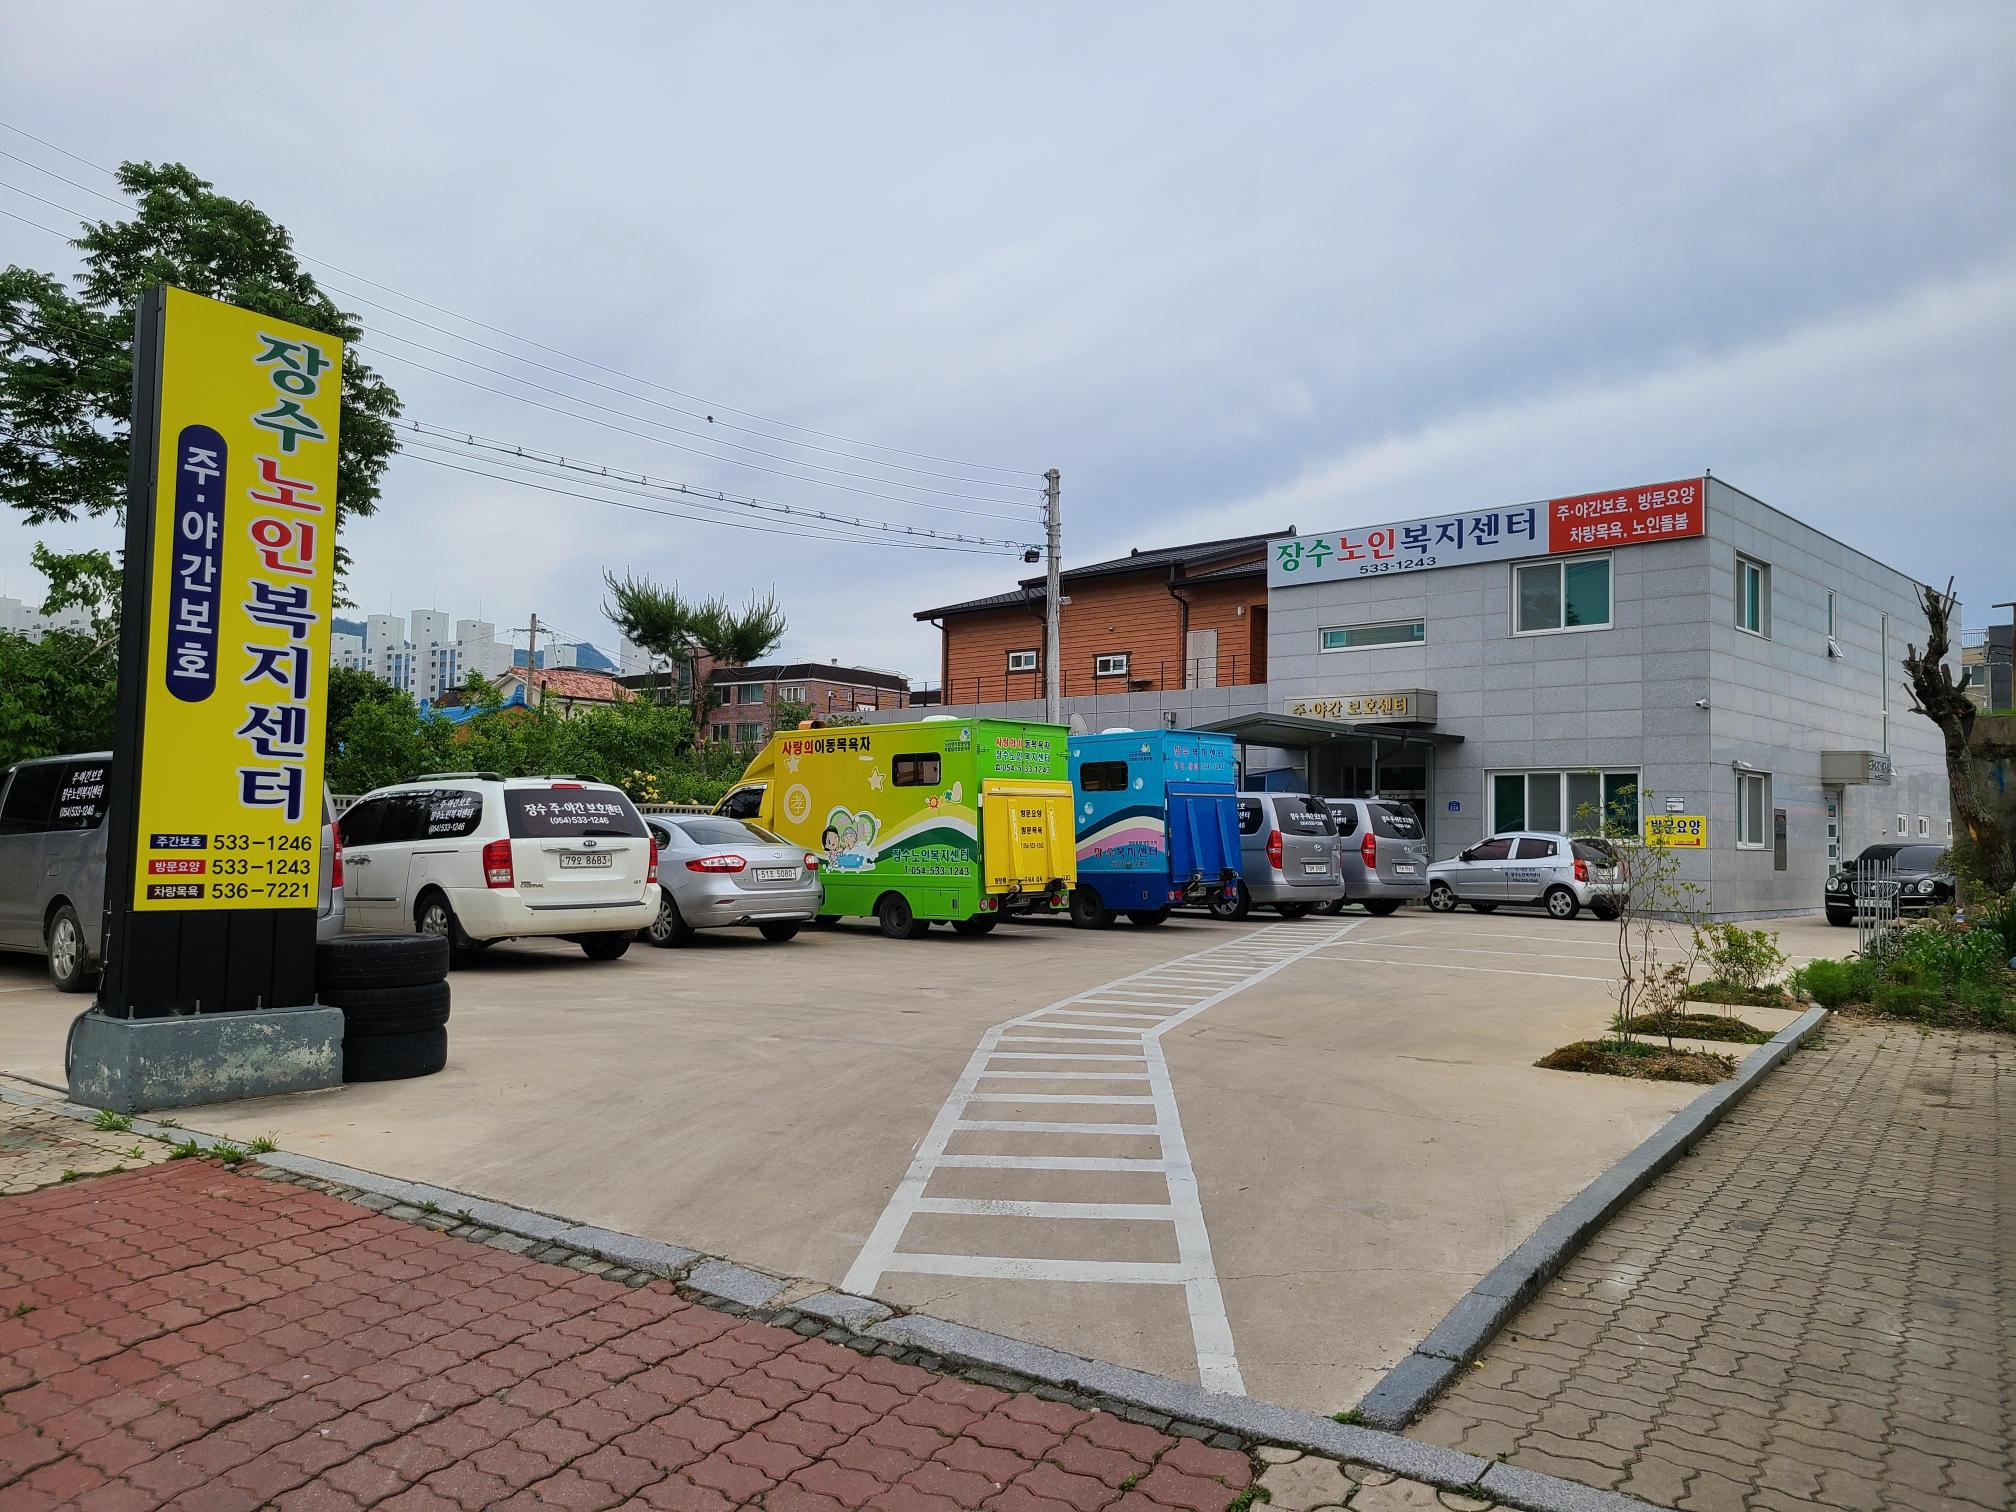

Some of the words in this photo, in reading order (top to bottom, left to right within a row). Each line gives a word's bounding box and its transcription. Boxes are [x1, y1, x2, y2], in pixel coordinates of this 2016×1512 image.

[1556, 496, 1633, 523] 주·야간보호,
[1638, 486, 1695, 512] 방문요양
[1569, 521, 1628, 544] 차량목욕,
[1631, 511, 1689, 536] 노인돌봄
[1276, 508, 1536, 572] 장수노인복지센터
[1359, 556, 1437, 575] 533-1243
[237, 333, 331, 823] 장수노인복지센터
[1347, 696, 1408, 716] 보호센터
[524, 803, 548, 816] 장수
[586, 803, 625, 817] 보호센터
[791, 794, 805, 814] 孝
[550, 816, 610, 825] (054)533-1246
[156, 836, 202, 848] 주간보호
[213, 834, 312, 851] 533-1246
[585, 855, 607, 865] 8683
[892, 848, 970, 863] 장수노인복지센터
[155, 861, 201, 873] 방문요양
[212, 859, 311, 875] 533-1243
[154, 885, 199, 898] 차량목욕
[211, 882, 309, 899] 536-7221
